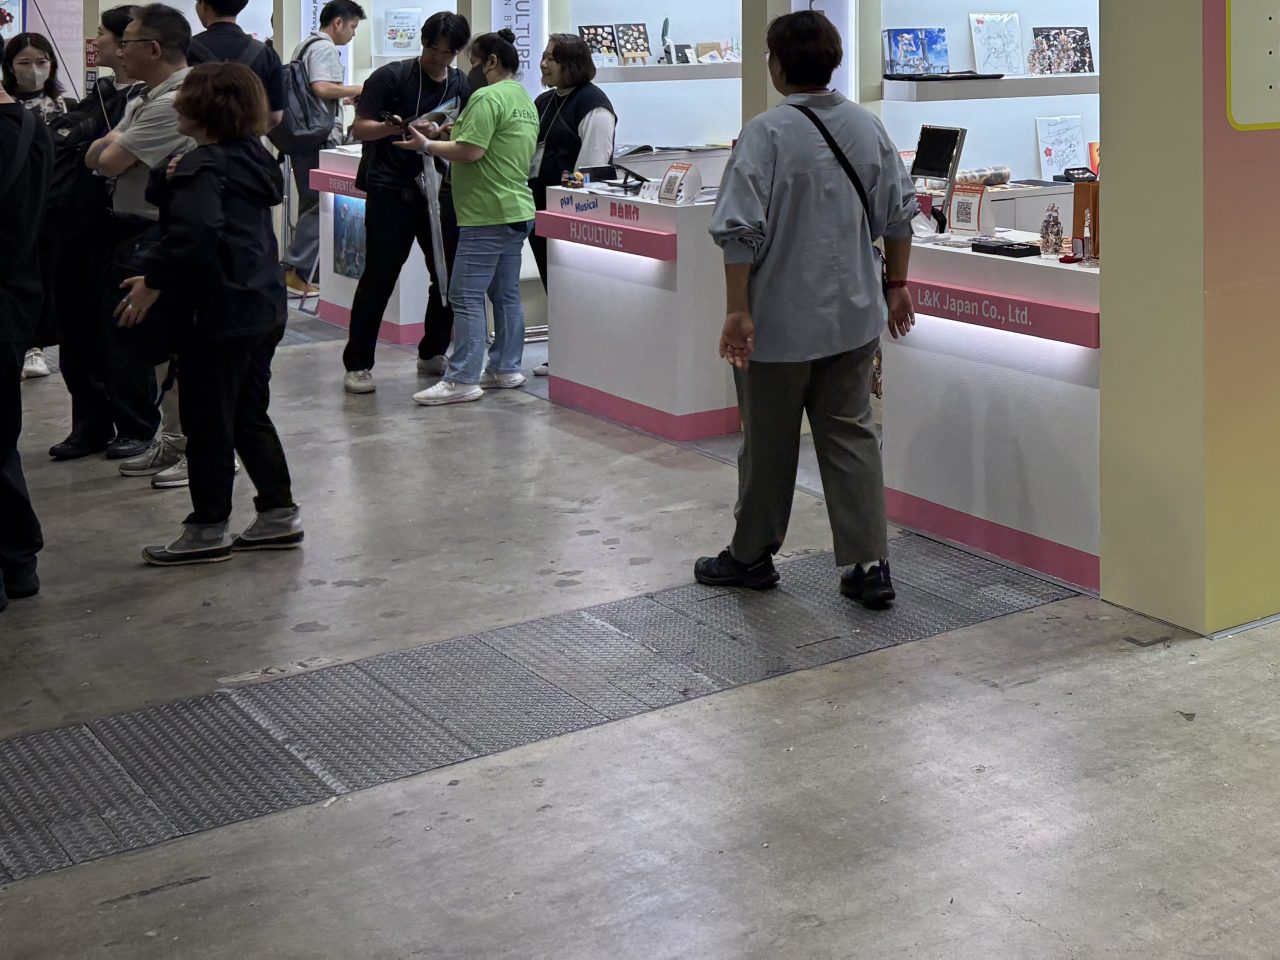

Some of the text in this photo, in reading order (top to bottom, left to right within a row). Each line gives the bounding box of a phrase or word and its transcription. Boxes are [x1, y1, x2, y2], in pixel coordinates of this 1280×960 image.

[560, 195, 573, 209] Play
[575, 198, 599, 213] Musical
[917, 289, 1032, 326] L&K Japan Co., Ltd.
